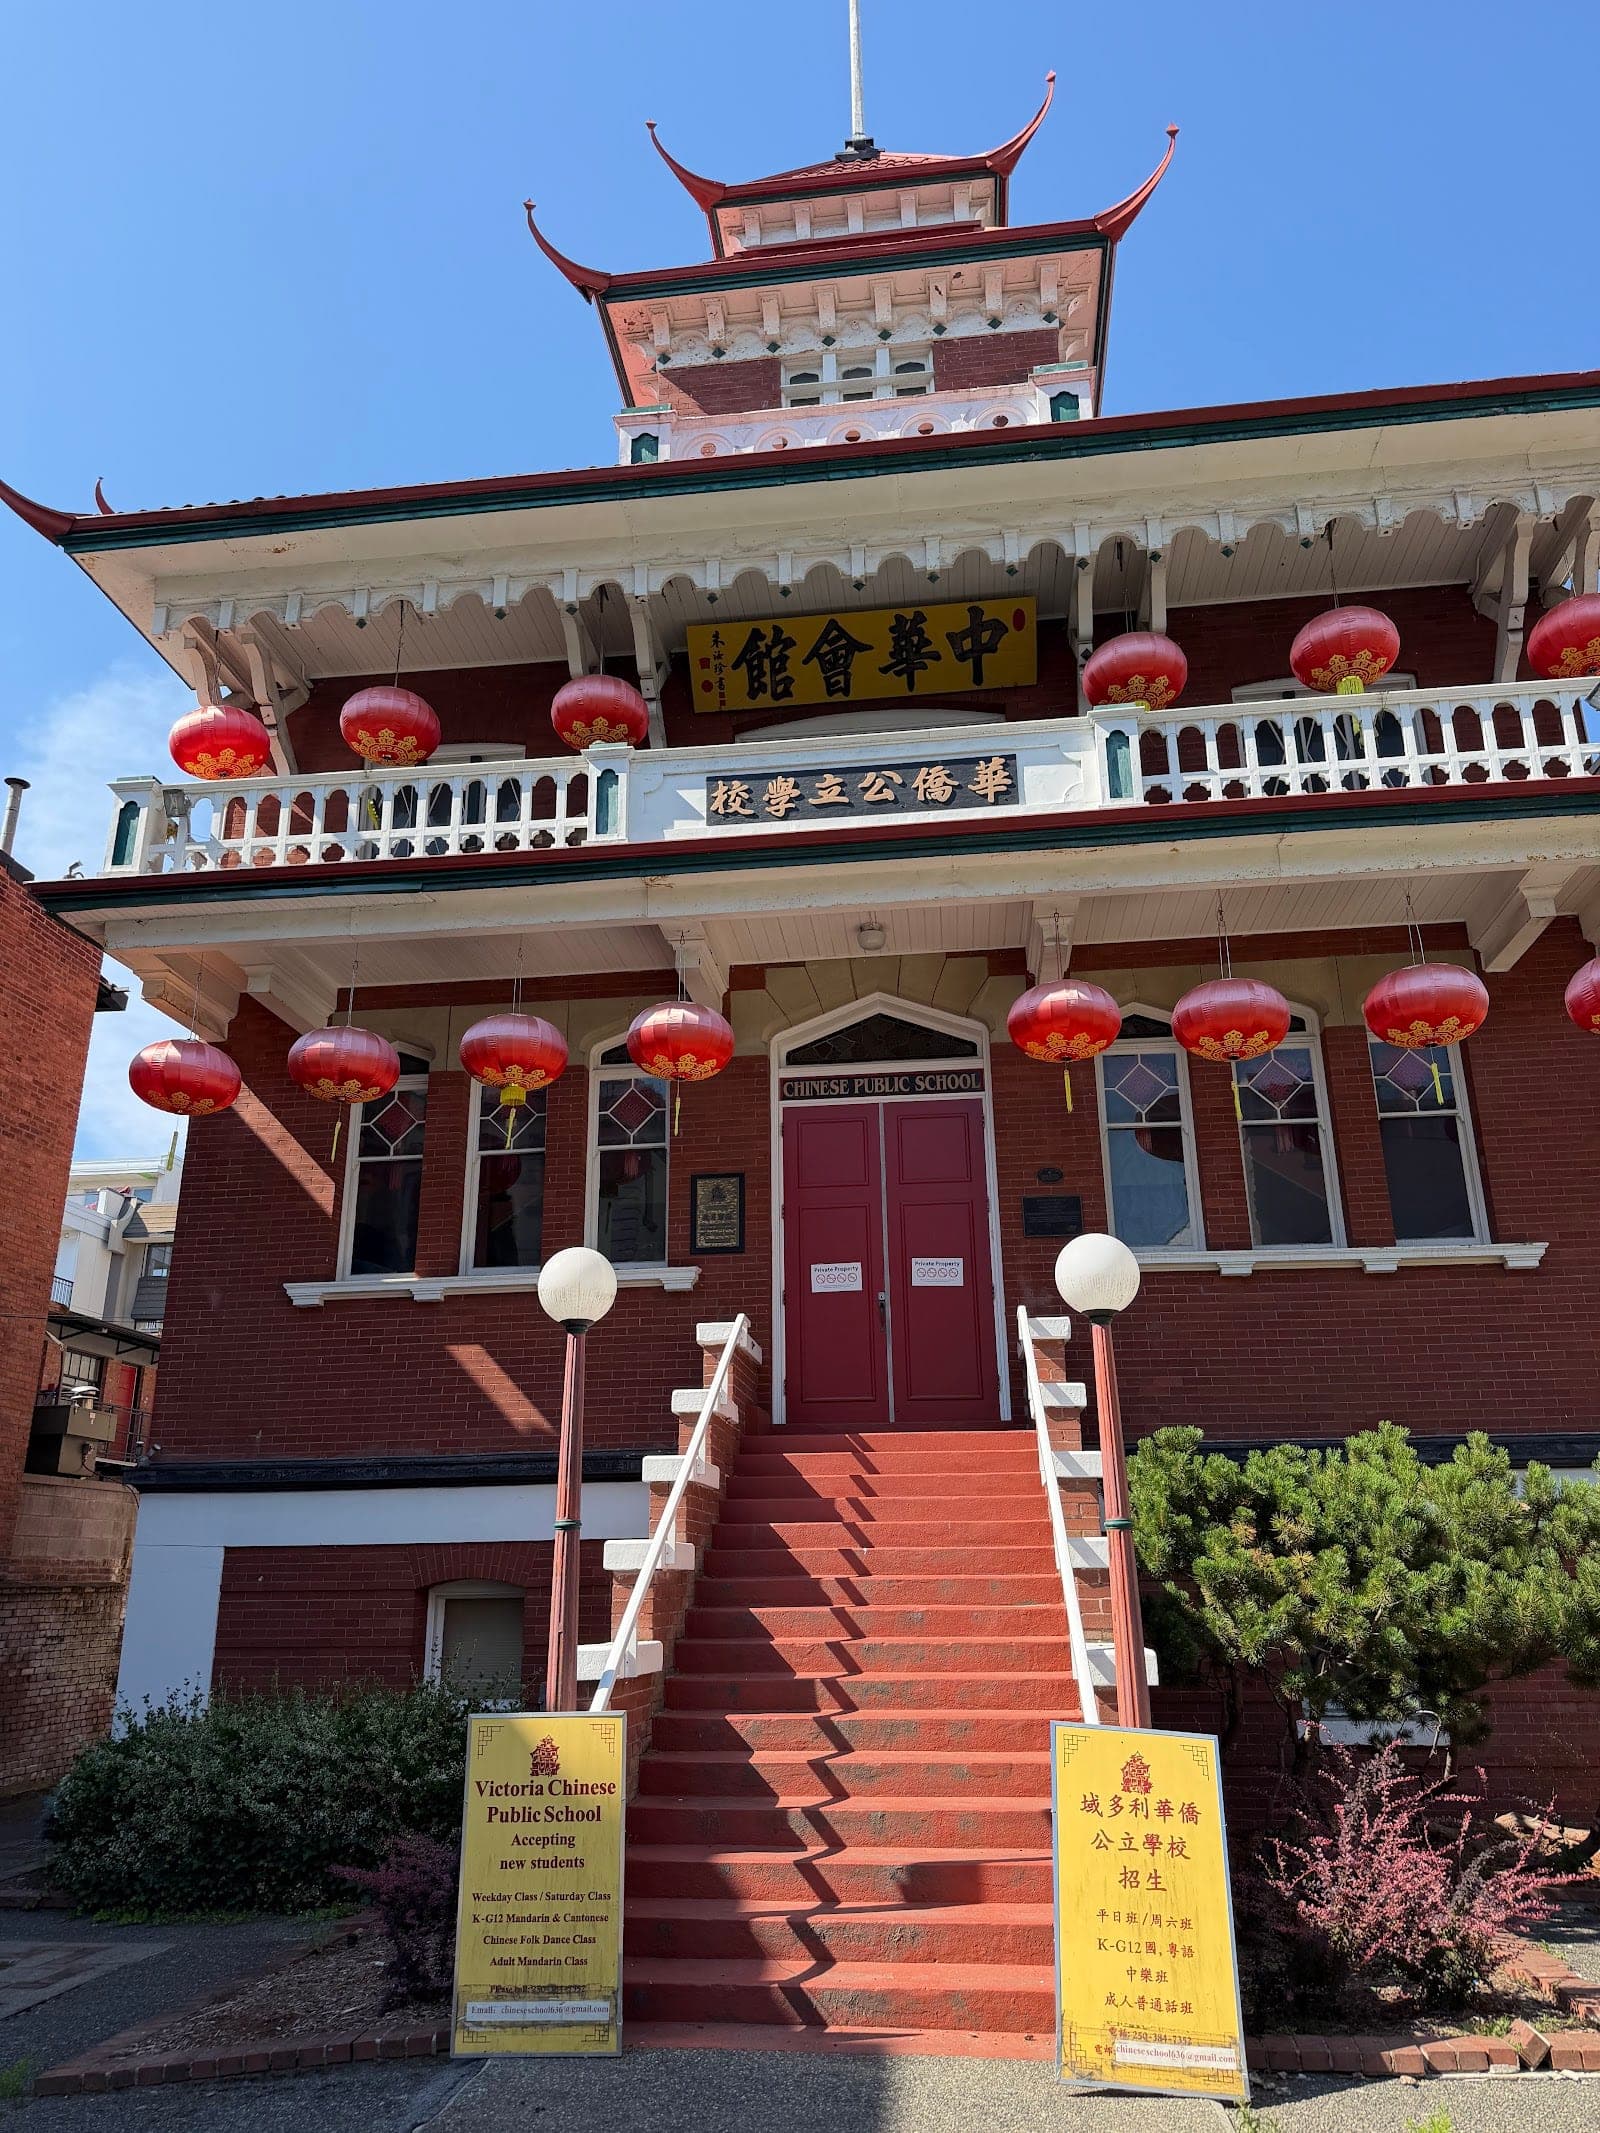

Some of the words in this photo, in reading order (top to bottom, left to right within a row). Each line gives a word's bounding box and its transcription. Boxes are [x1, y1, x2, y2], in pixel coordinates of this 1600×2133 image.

[783, 1079, 850, 1097] CHINESE
[854, 1075, 911, 1094] PUBLIC
[914, 1073, 982, 1091] SCHOOL
[834, 1265, 858, 1273] Property
[936, 1260, 960, 1268] Property
[474, 1780, 544, 1797] Victoria
[547, 1779, 617, 1796] Chinese
[487, 1806, 541, 1823] Public
[543, 1805, 602, 1823] School
[1079, 1791, 1202, 1826] 域多利華僑
[511, 1833, 576, 1849] Accepting
[1090, 1829, 1192, 1860] 公立學校
[500, 1858, 527, 1870] new
[530, 1856, 585, 1870] students
[1118, 1865, 1168, 1892] 招生
[472, 1892, 513, 1904] Weekday
[514, 1892, 538, 1902] Class
[544, 1891, 585, 1903] Saturday
[587, 1891, 611, 1901] Class
[472, 1913, 504, 1924] K-G12
[506, 1913, 550, 1923] Mandarin
[552, 1913, 561, 1923] &
[563, 1913, 609, 1923] Cantonese
[483, 1935, 518, 1945] Chinese
[520, 1935, 540, 1945] Folk
[542, 1934, 571, 1945] Dance
[572, 1934, 597, 1944] Class
[489, 1957, 515, 1967] Adult
[517, 1956, 562, 1966] Mandarin
[564, 1956, 588, 1966] Class
[1126, 1965, 1169, 1984] 中樂班
[471, 2006, 496, 2014] Email:
[1104, 1991, 1194, 2015] 成人普通話班
